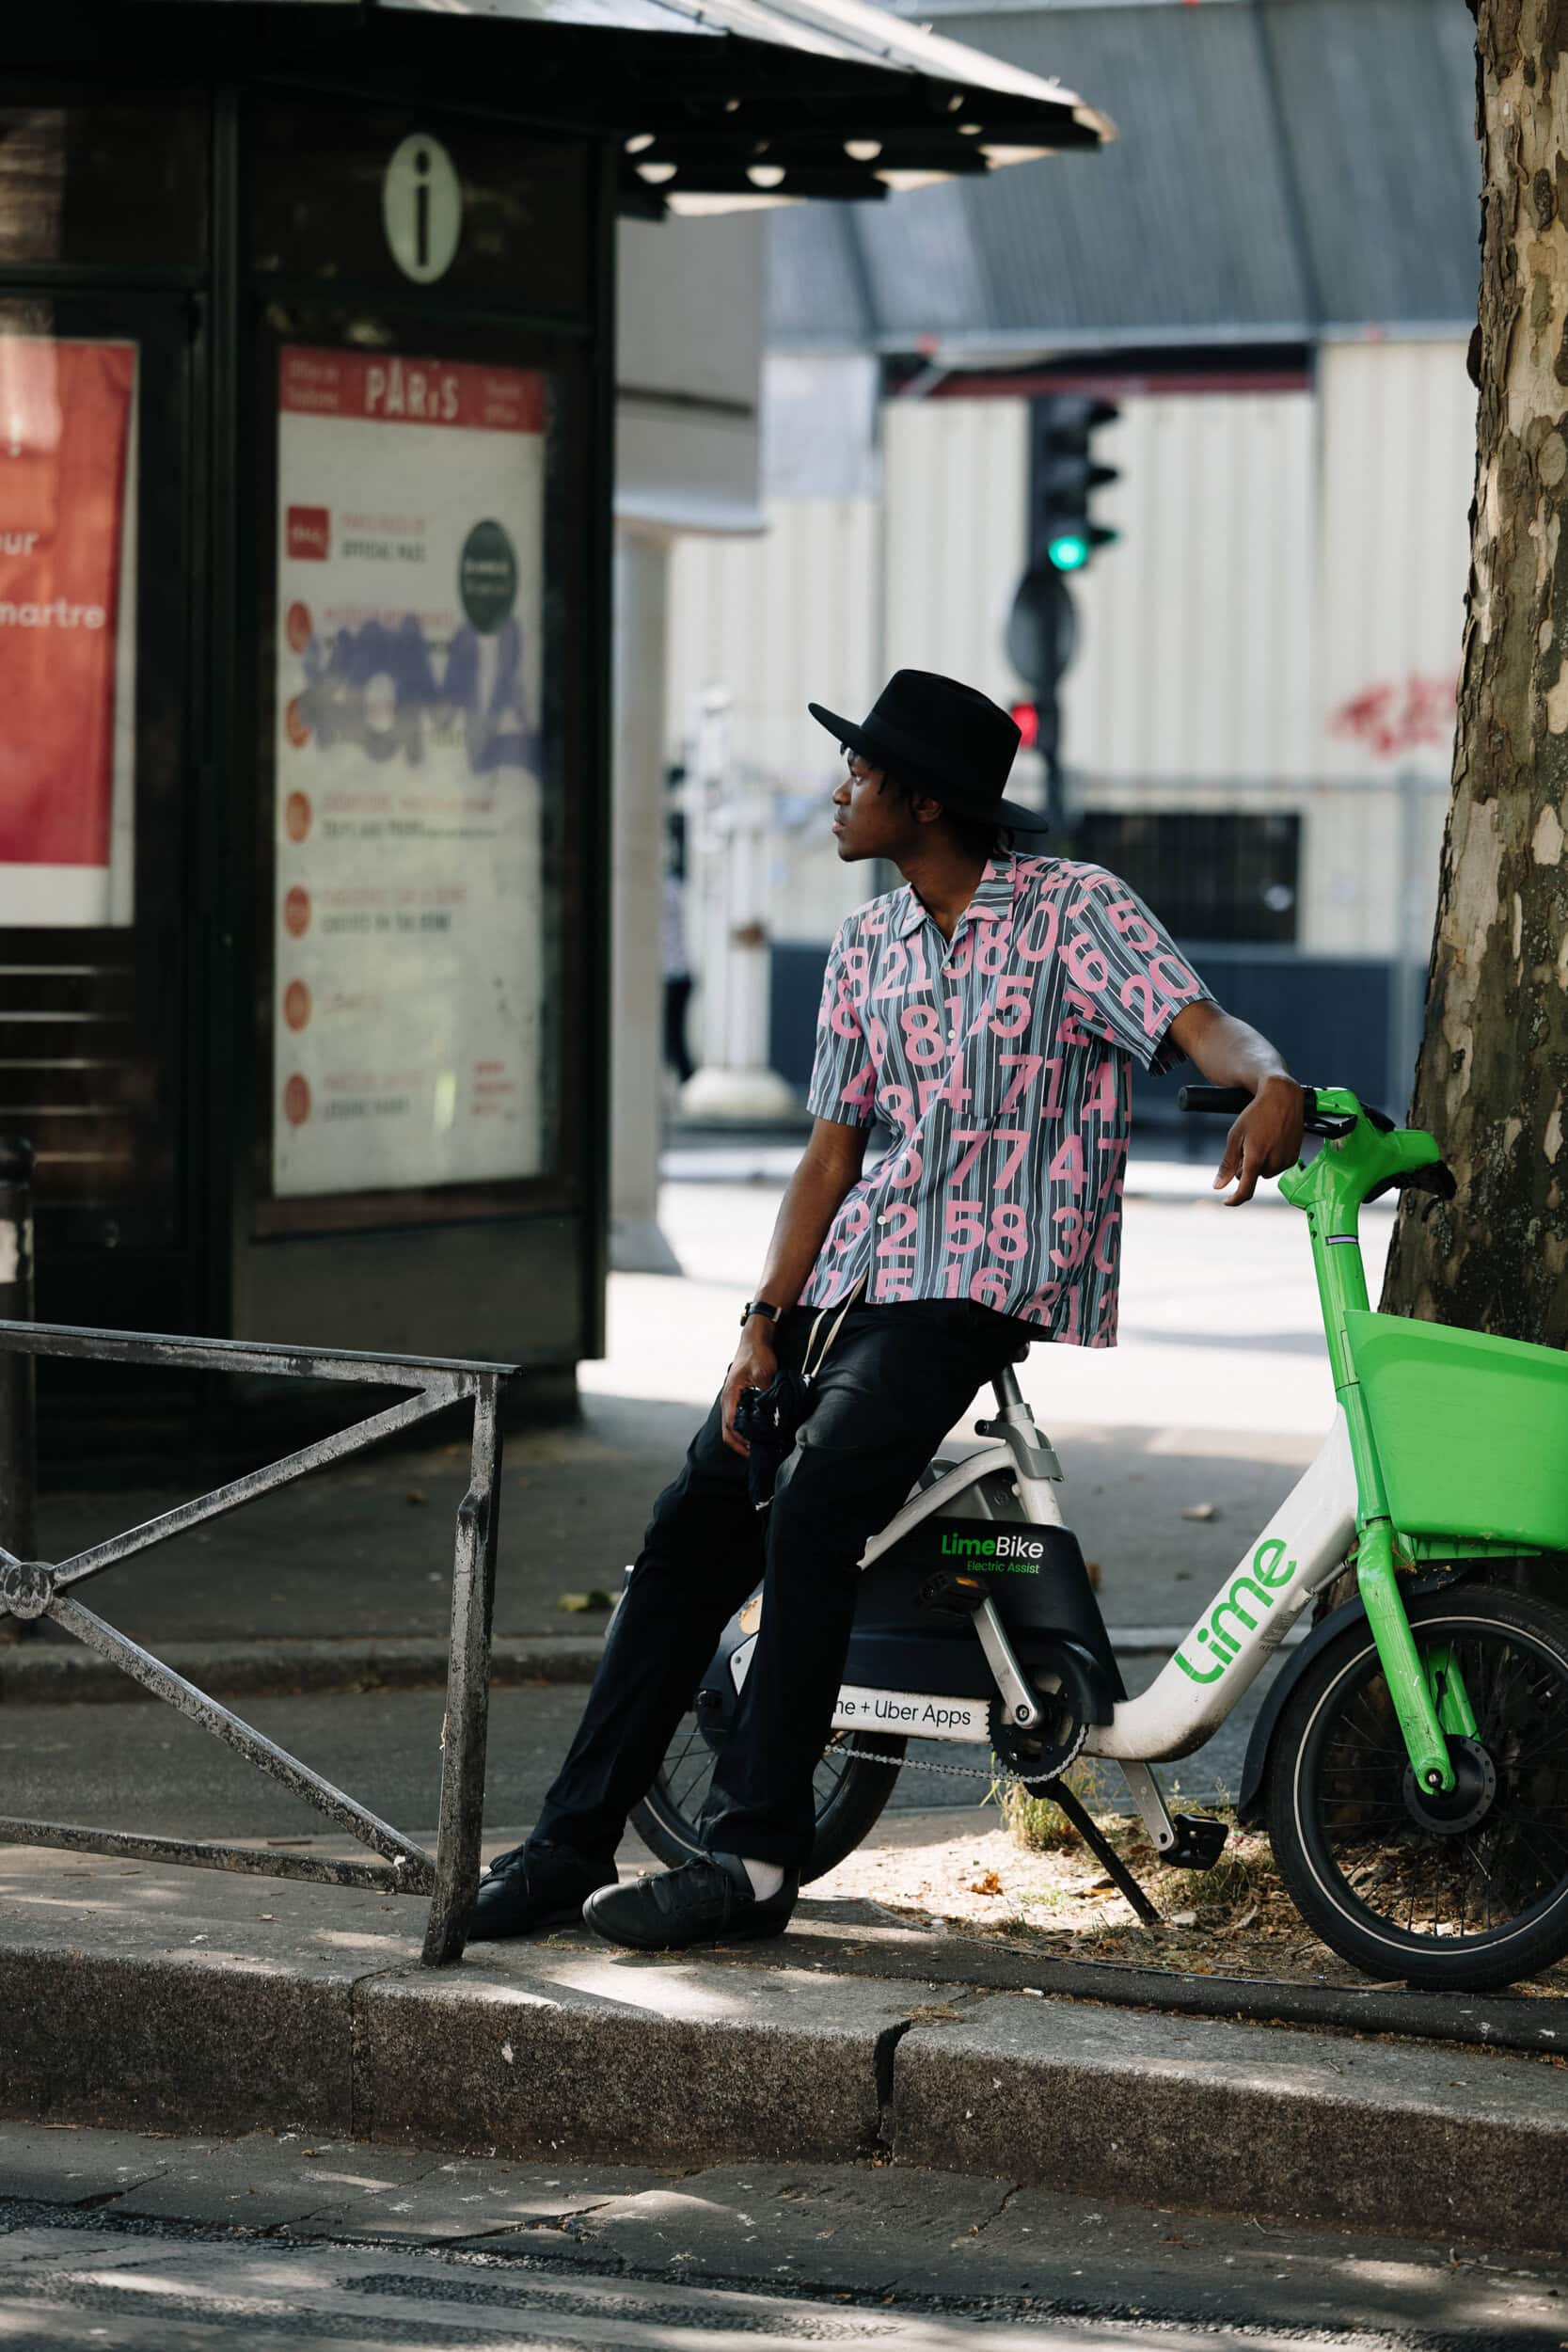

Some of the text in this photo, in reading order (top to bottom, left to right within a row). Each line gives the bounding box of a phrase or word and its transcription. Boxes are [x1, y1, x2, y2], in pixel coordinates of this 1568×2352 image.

[1105, 900, 1159, 951] 5
[1069, 932, 1109, 993] 6
[989, 975, 1032, 1039] 5
[1120, 975, 1172, 1037] 2
[1049, 1135, 1088, 1195] 4
[876, 1203, 919, 1257] 2
[941, 1532, 1044, 1559] LimeBike
[967, 1560, 1039, 1574] Electric Assist
[1173, 1538, 1297, 1684] Lime
[875, 1699, 918, 1721] Uber
[922, 1704, 971, 1728] Apps
